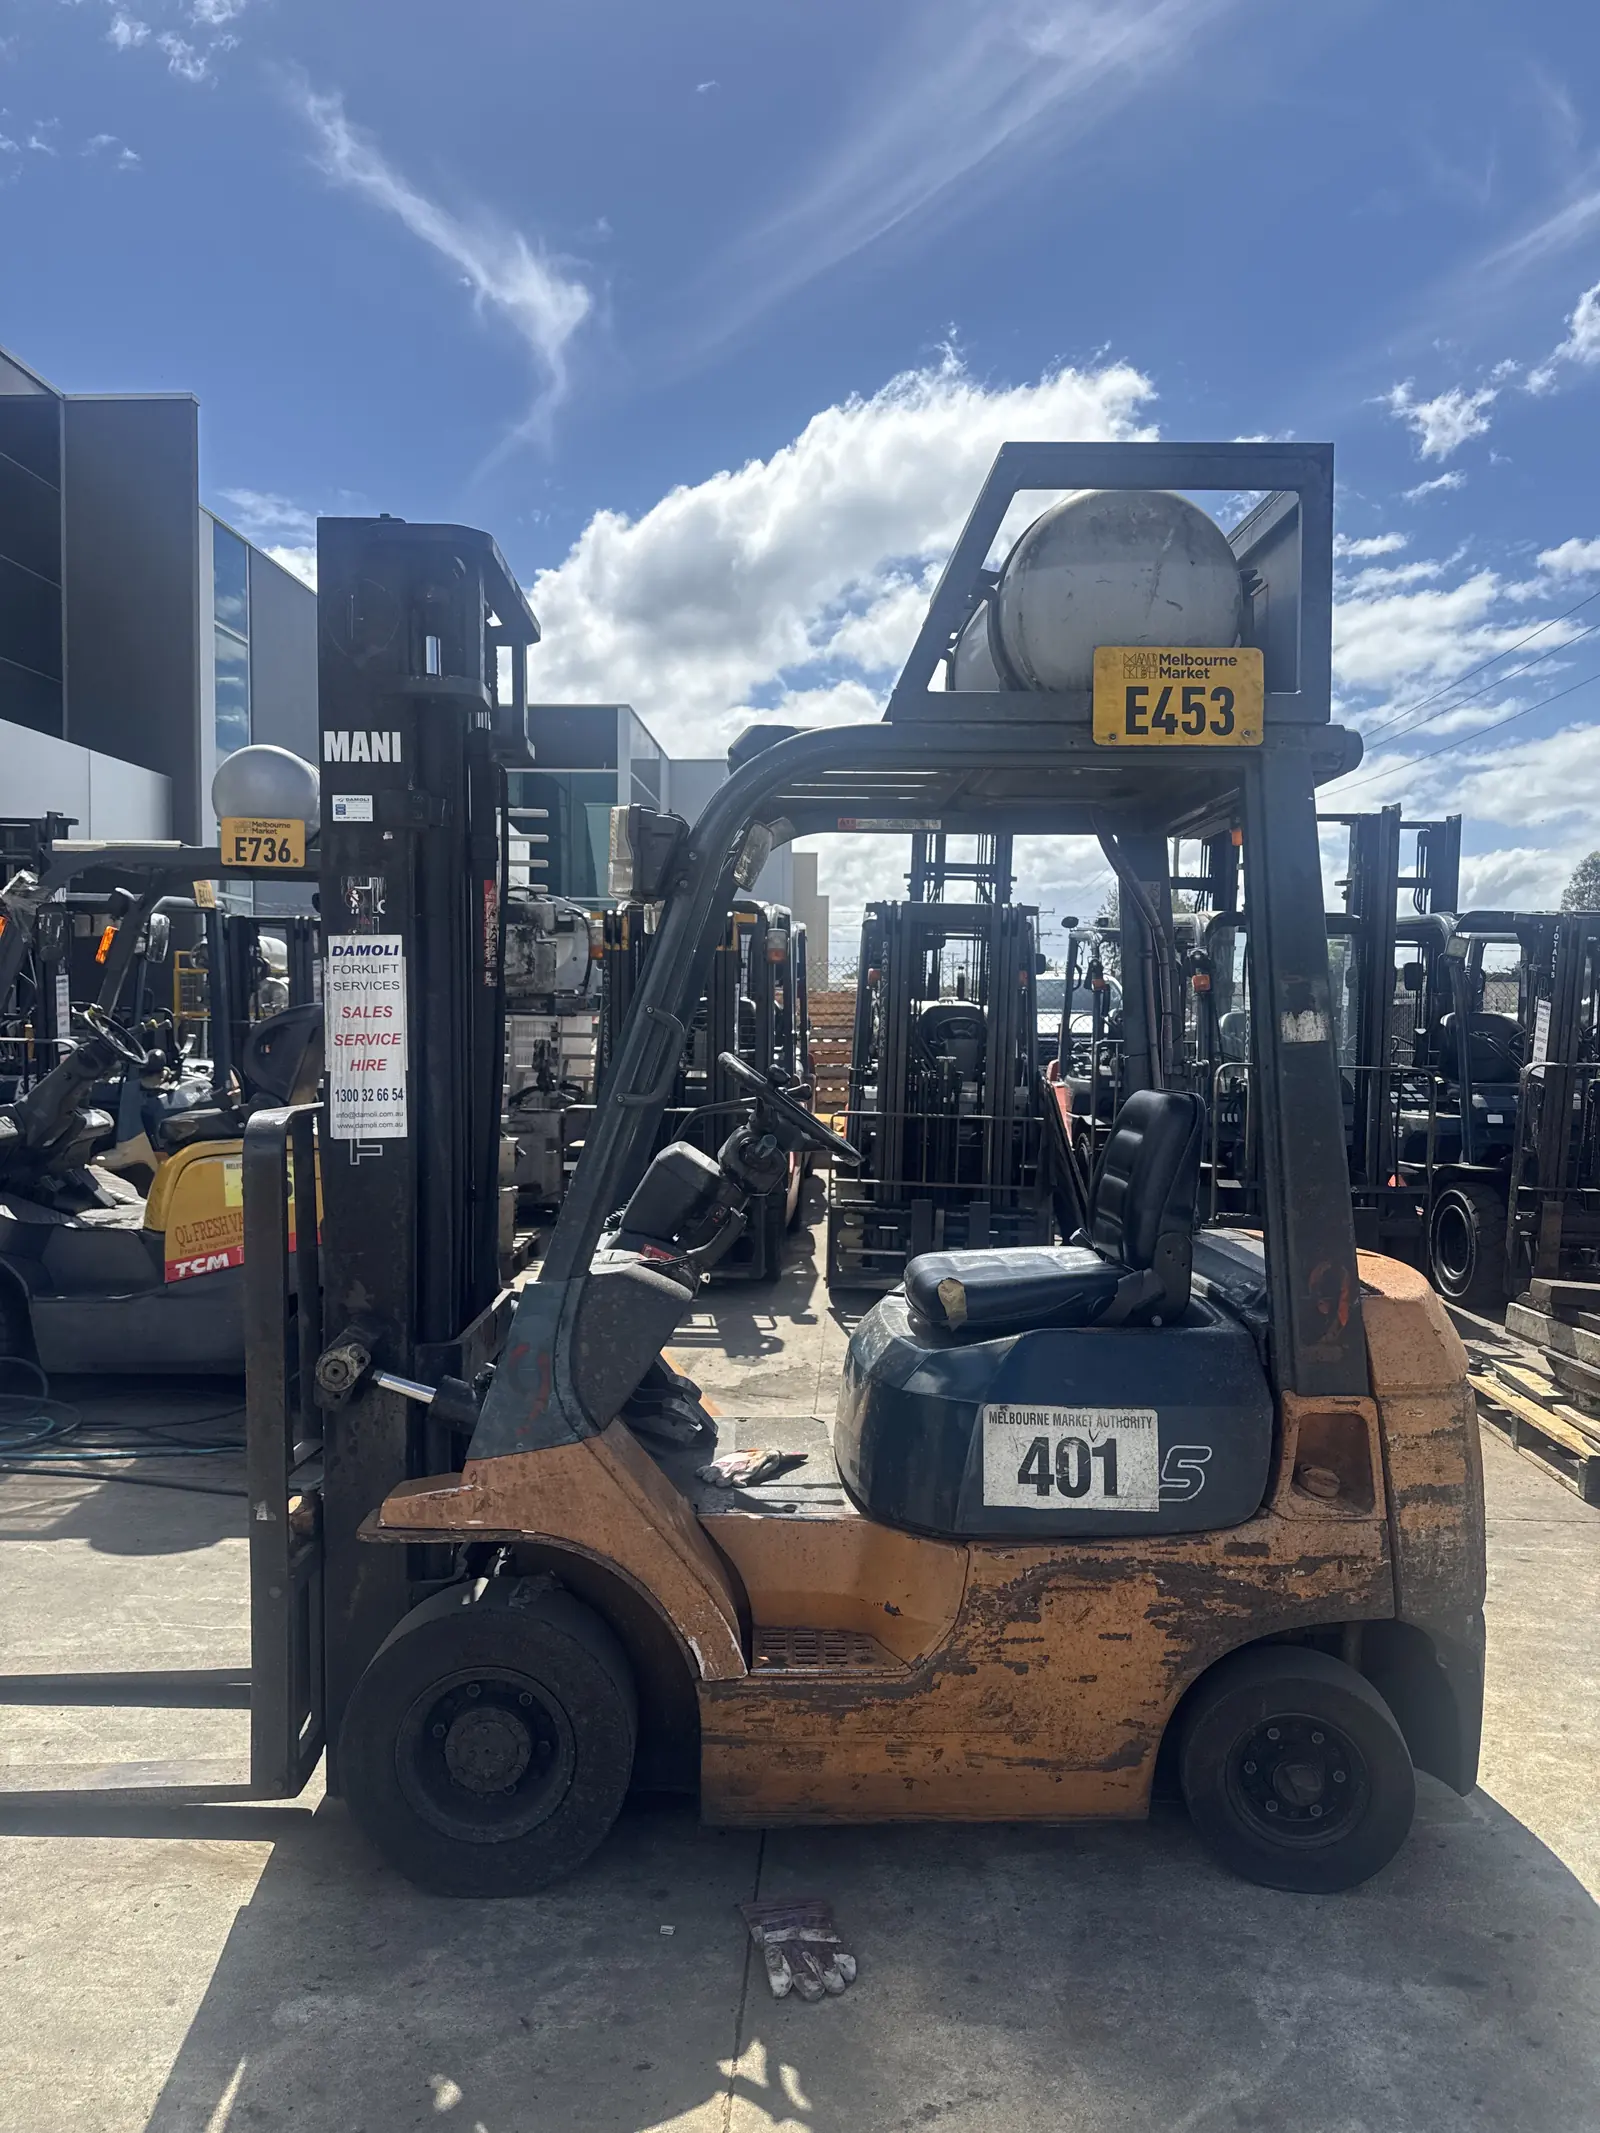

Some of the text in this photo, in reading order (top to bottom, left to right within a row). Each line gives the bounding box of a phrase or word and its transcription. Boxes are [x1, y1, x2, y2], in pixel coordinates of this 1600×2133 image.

[1159, 653, 1238, 666] Melbourne
[1159, 667, 1210, 679] Market
[1125, 686, 1235, 736] E453
[323, 731, 401, 763] MANI
[252, 821, 291, 829] Melbourne
[235, 836, 291, 863] E736
[332, 944, 399, 957] DAMOLI
[332, 964, 399, 975] FORKLIFT
[333, 980, 400, 991] SERVICES
[342, 1005, 393, 1019] SALES
[334, 1033, 402, 1046] SERVICE
[350, 1059, 387, 1072] HIRE
[335, 1087, 404, 1102] 1300 32 66 54
[336, 1111, 403, 1119] info@damoli.com.au
[175, 1225, 192, 1247] QL
[192, 1214, 230, 1241] FRESH
[175, 1252, 229, 1277] TCM
[988, 1411, 1152, 1429] MELBOURNE MARKET AUTHORITY
[1017, 1436, 1119, 1499] 401
